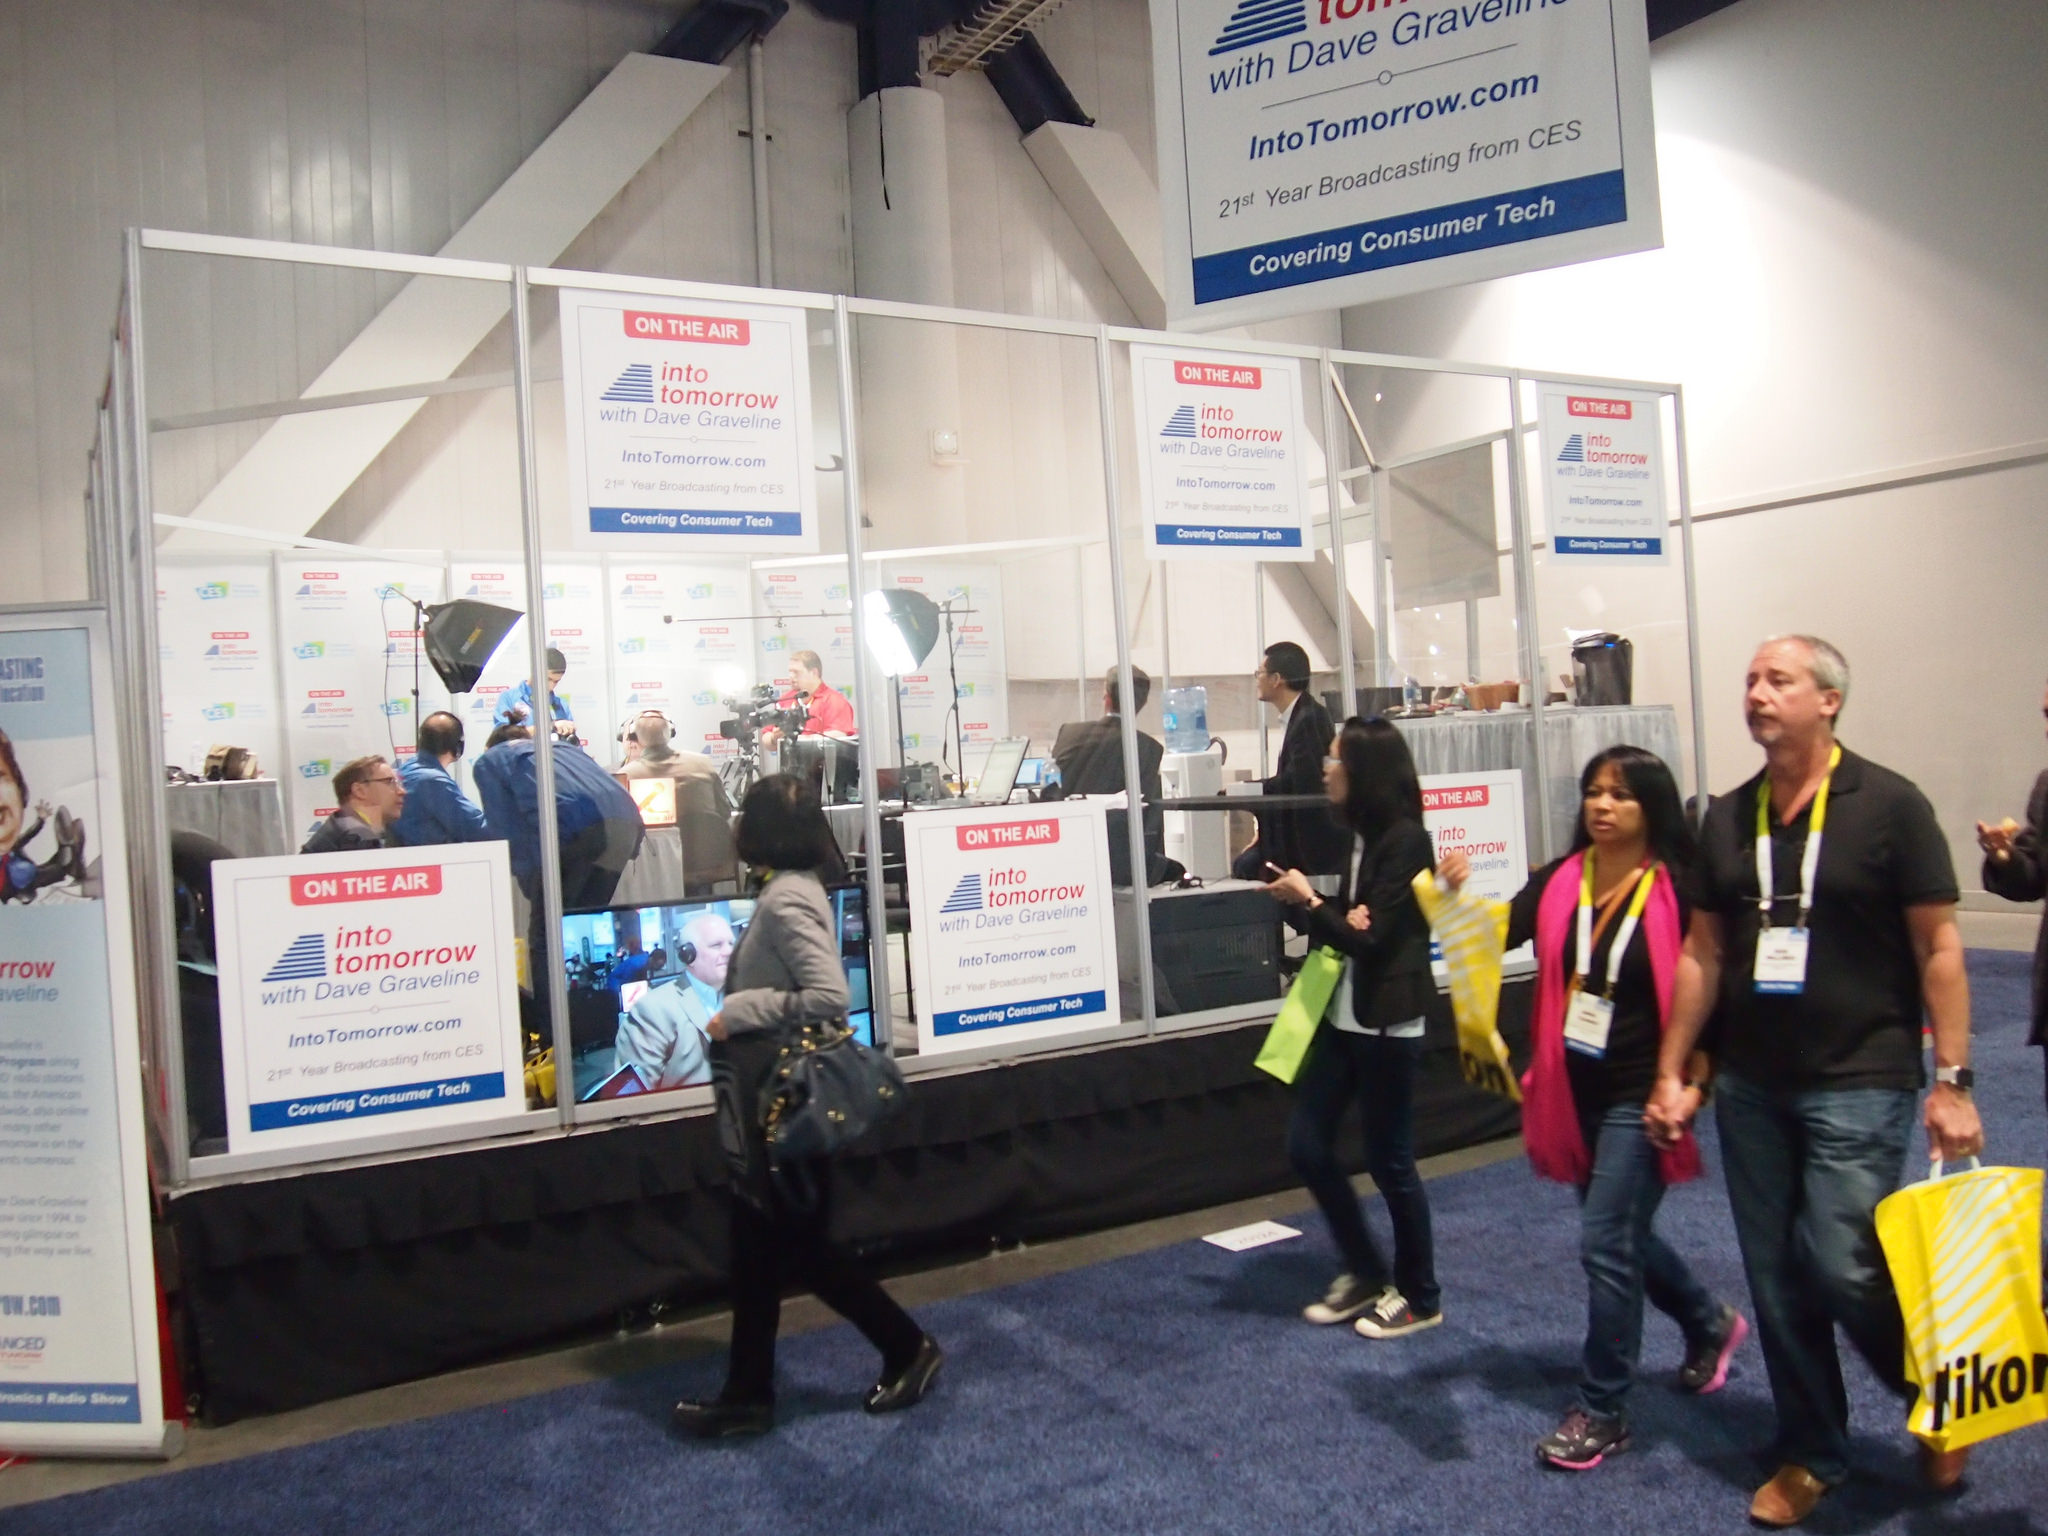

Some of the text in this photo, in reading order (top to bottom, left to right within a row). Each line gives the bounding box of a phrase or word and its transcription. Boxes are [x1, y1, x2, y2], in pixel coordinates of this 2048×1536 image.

[1210, 53, 1274, 94] with
[1288, 27, 1377, 74] Dave
[1393, 0, 1567, 46] Gravelin
[1250, 75, 1539, 159] IntoTomorrow.com
[1219, 121, 1582, 219] 21st Year Broadcasting from CES
[1250, 196, 1556, 277] Covering Consumer Tech
[635, 317, 739, 339] ON THE AIR
[661, 362, 708, 383] into
[1182, 367, 1254, 384] ON THE AIR
[661, 385, 779, 409] tomorrow
[1201, 404, 1233, 421] into
[1590, 402, 1608, 413] THE
[600, 407, 781, 430] with Dave Graveline
[1201, 424, 1282, 442] tomorrow
[1587, 432, 1611, 447] into
[622, 451, 766, 467] IntoTomorrow.com
[1160, 442, 1286, 459] with Dave Graveline
[1587, 450, 1648, 465] tomorrow
[631, 479, 655, 490] Year
[660, 481, 729, 494] Broadcasting
[733, 483, 756, 493] from
[760, 483, 784, 494] CES
[1176, 477, 1275, 491] IntoTomorrow.com
[621, 512, 772, 527] Covering Consumer Tech
[1177, 529, 1281, 540] Covering Consumer Tech
[1423, 790, 1483, 805] ON THE AIR
[965, 825, 1051, 845] ON THE AIR
[1438, 826, 1465, 841] into
[1468, 857, 1509, 872] raveline
[304, 873, 428, 898] ON THE AIR
[989, 867, 1027, 886] into
[989, 884, 1085, 908] tomorrow
[940, 905, 1088, 933] with Dave Graveline
[336, 925, 392, 949] into
[335, 944, 477, 974] tomorrow
[959, 944, 1076, 968] IntoTomorrow.com
[1072, 967, 1091, 978] CES
[262, 969, 480, 1006] with Dave Graveline
[959, 998, 1083, 1025] Covering Consumer Tech
[289, 1018, 462, 1048] IntoTomorrow.com
[455, 1045, 484, 1057] CES
[288, 1081, 470, 1118] Covering Consumer Tech
